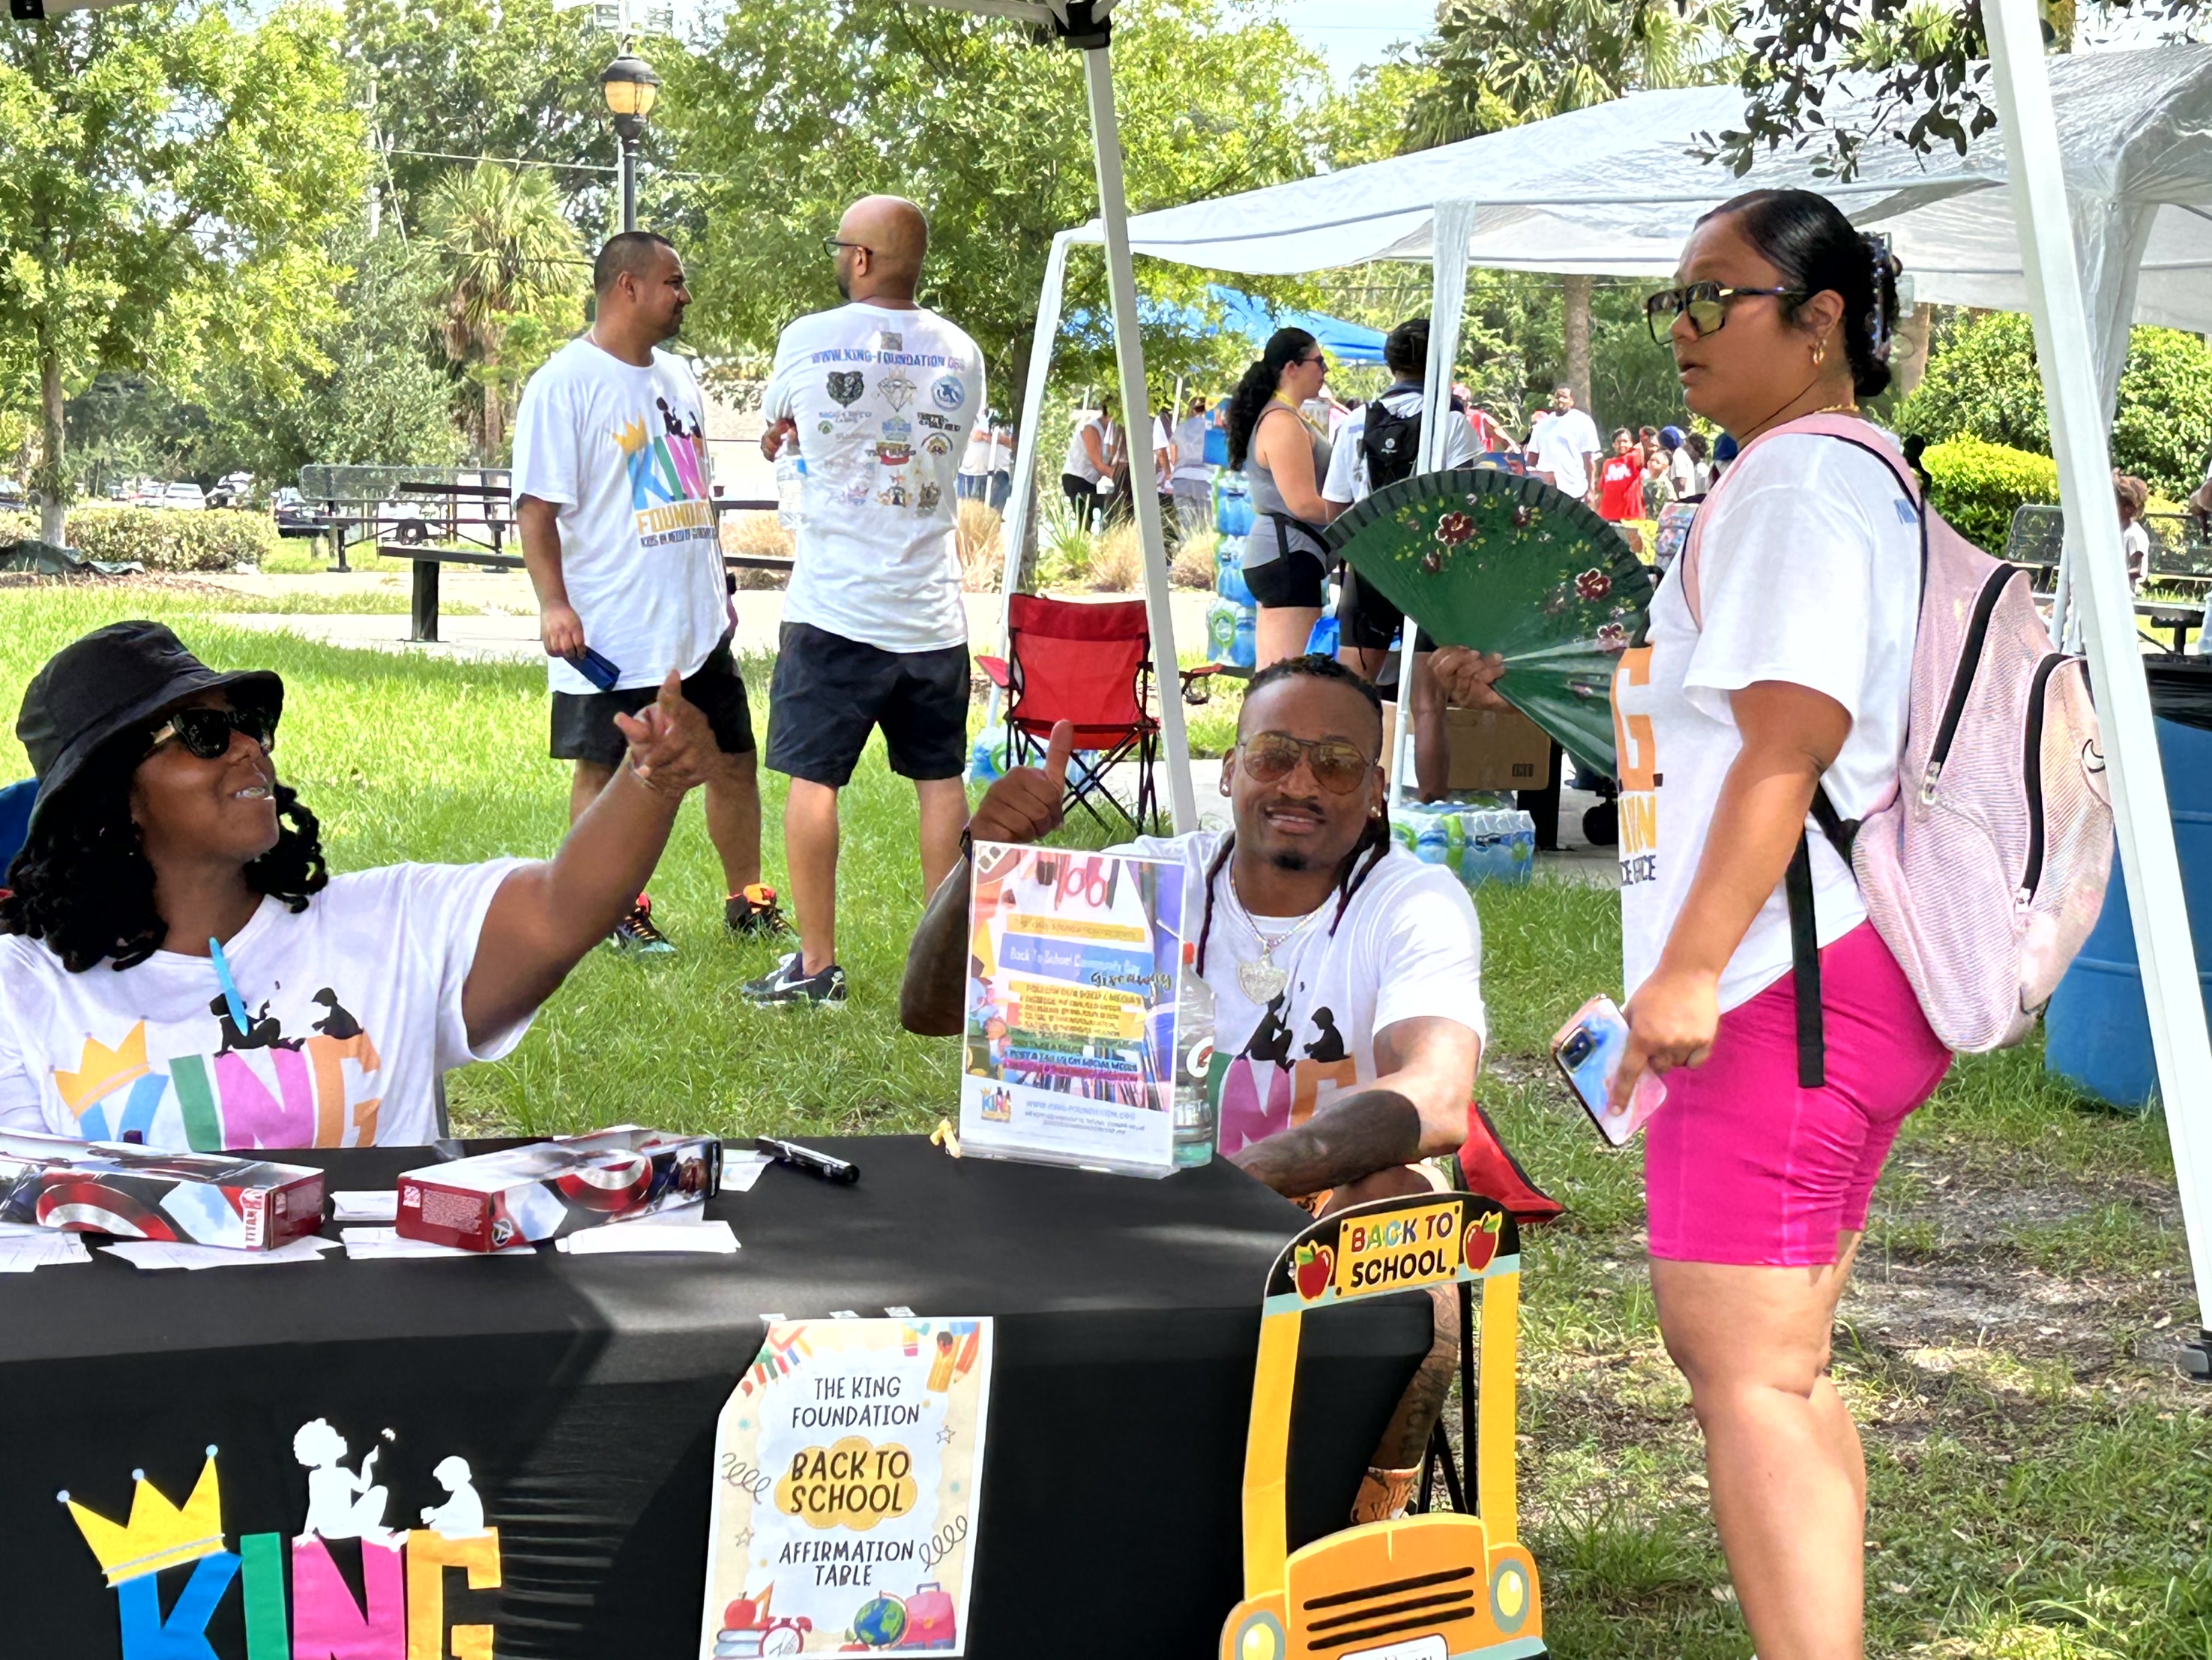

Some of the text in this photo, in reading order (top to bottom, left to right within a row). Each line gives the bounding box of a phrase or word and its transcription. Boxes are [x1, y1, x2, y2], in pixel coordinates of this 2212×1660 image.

[1351, 1212, 1453, 1253] BACK TO
[1350, 1248, 1447, 1288] SCHOOL
[814, 1377, 902, 1401] THE KING
[792, 1404, 920, 1428] FOUNDATION
[791, 1450, 910, 1482] BACK TO
[790, 1482, 903, 1513] SCHOOL
[779, 1540, 914, 1564] AFFIRMATION
[815, 1564, 873, 1587] TABLE
[118, 1527, 501, 1660] KING
